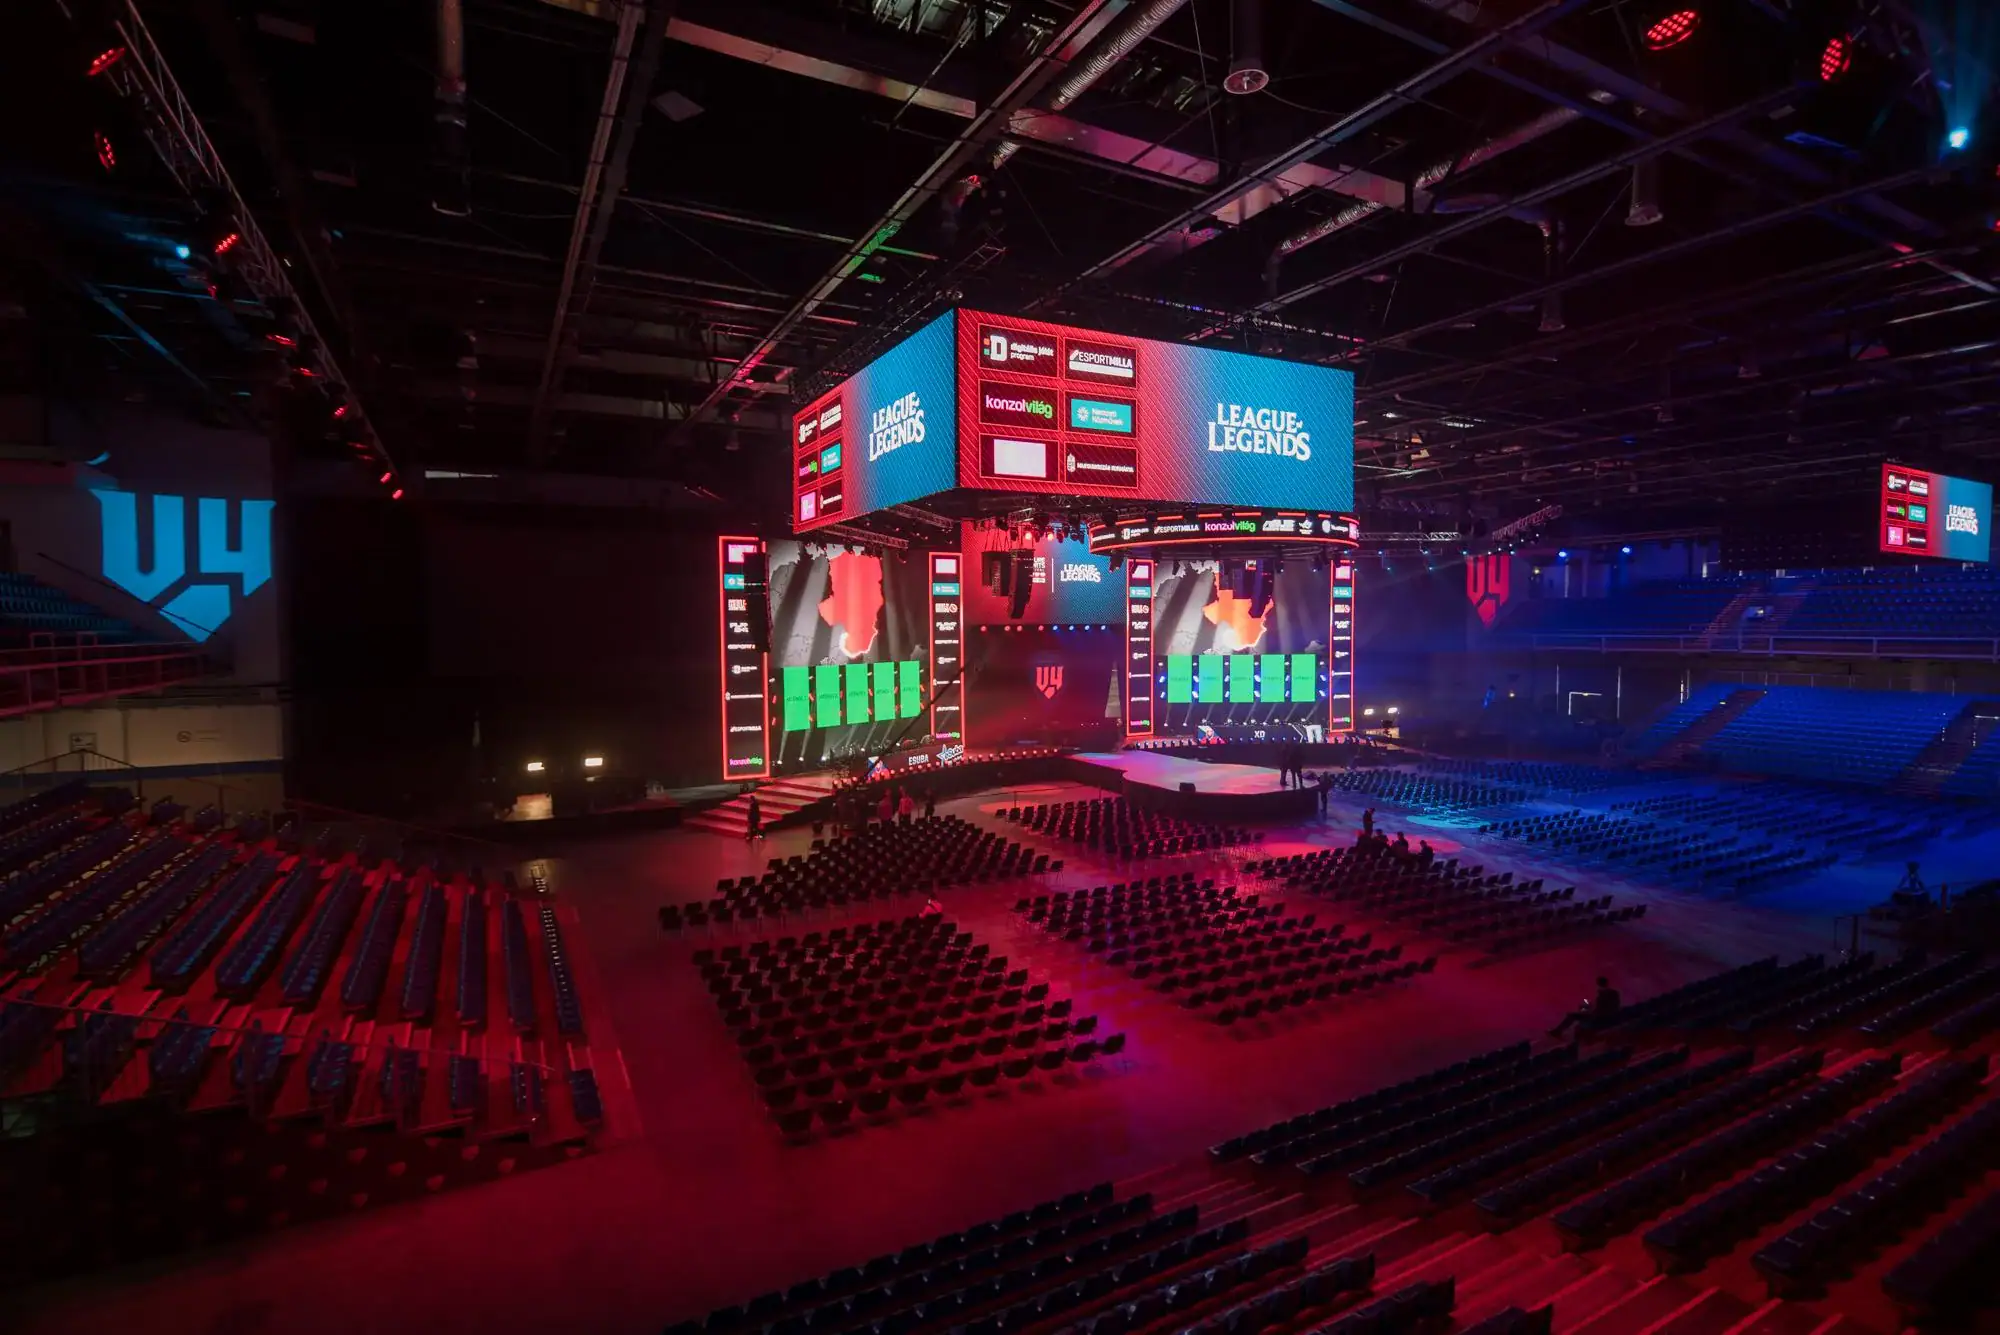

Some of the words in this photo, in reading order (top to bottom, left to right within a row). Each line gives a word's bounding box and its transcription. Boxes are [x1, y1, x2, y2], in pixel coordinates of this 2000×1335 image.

[1078, 351, 1133, 369] ESPORTMILLA
[872, 391, 916, 433] LEAGUE
[985, 395, 1053, 419] konzolvilág
[1217, 403, 1298, 434] LEAGUE
[869, 408, 925, 462] LEGENDS
[1207, 421, 1311, 461] LEGENDS
[1945, 514, 1978, 535] LEGENDS
[1060, 570, 1101, 582] LEGENDS
[1063, 564, 1096, 573] LEAGUE
[908, 753, 929, 766] ESUBA
